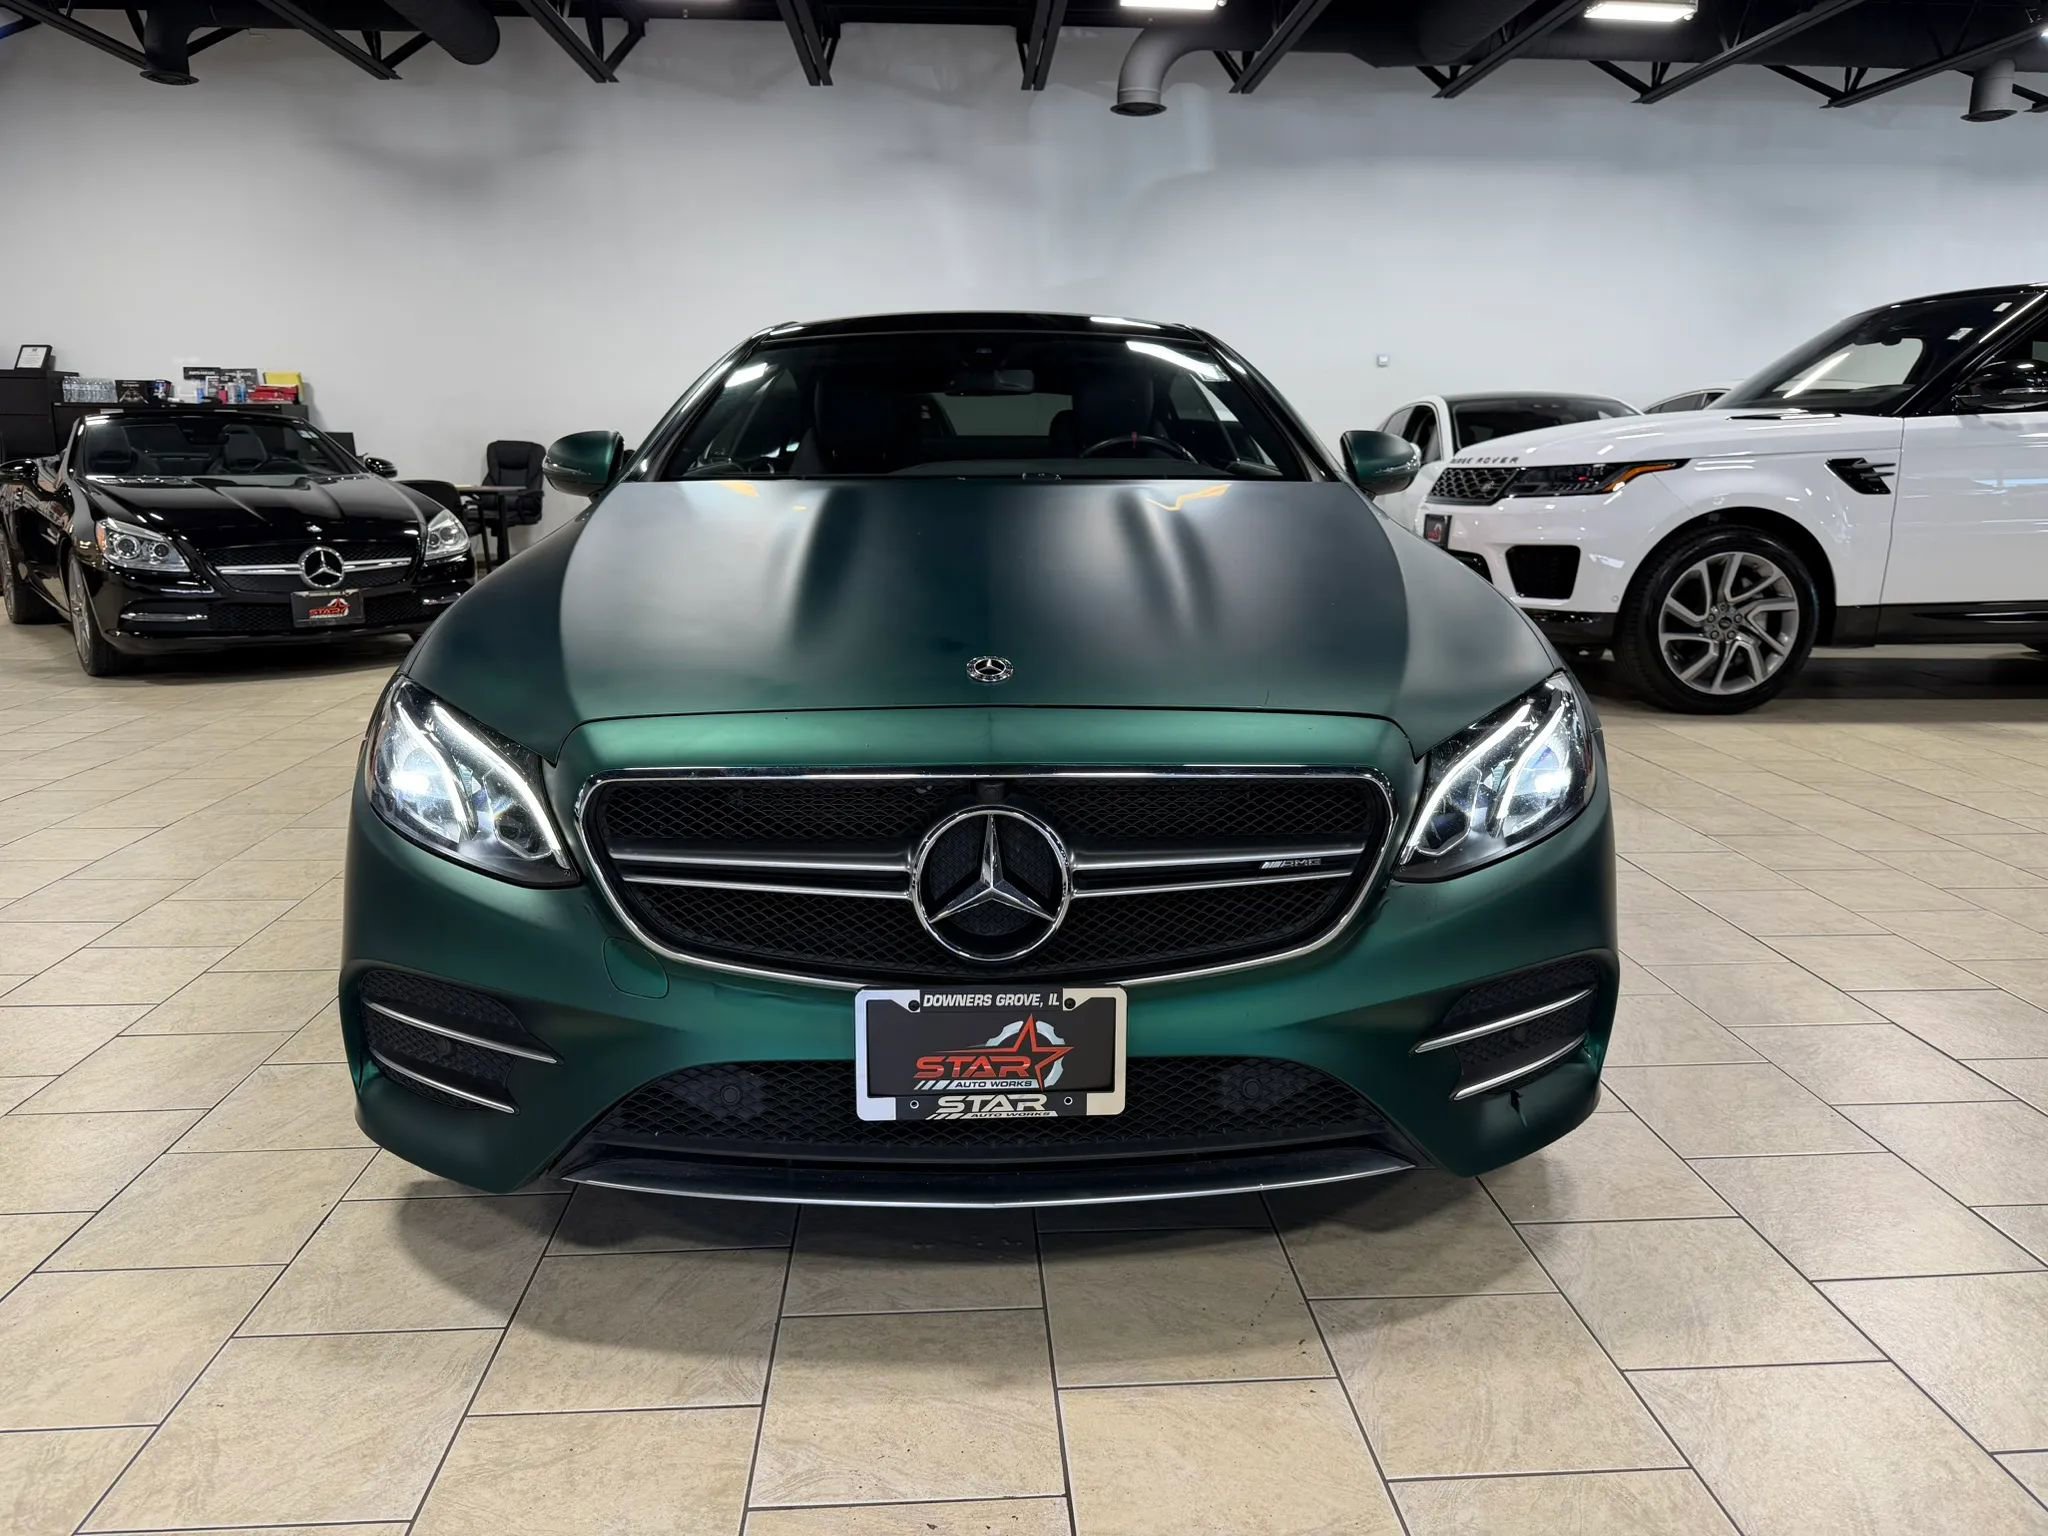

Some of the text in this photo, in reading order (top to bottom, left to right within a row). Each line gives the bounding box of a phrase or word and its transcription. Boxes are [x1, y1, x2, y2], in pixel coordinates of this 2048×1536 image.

[1476, 456, 1519, 464] ROVER
[1280, 858, 1321, 868] AMG
[923, 993, 1060, 1008] DOWNERS GROVE, IL
[913, 1056, 1032, 1079] STAR
[990, 1080, 1032, 1088] WORKS
[935, 1094, 1048, 1113] STAR
